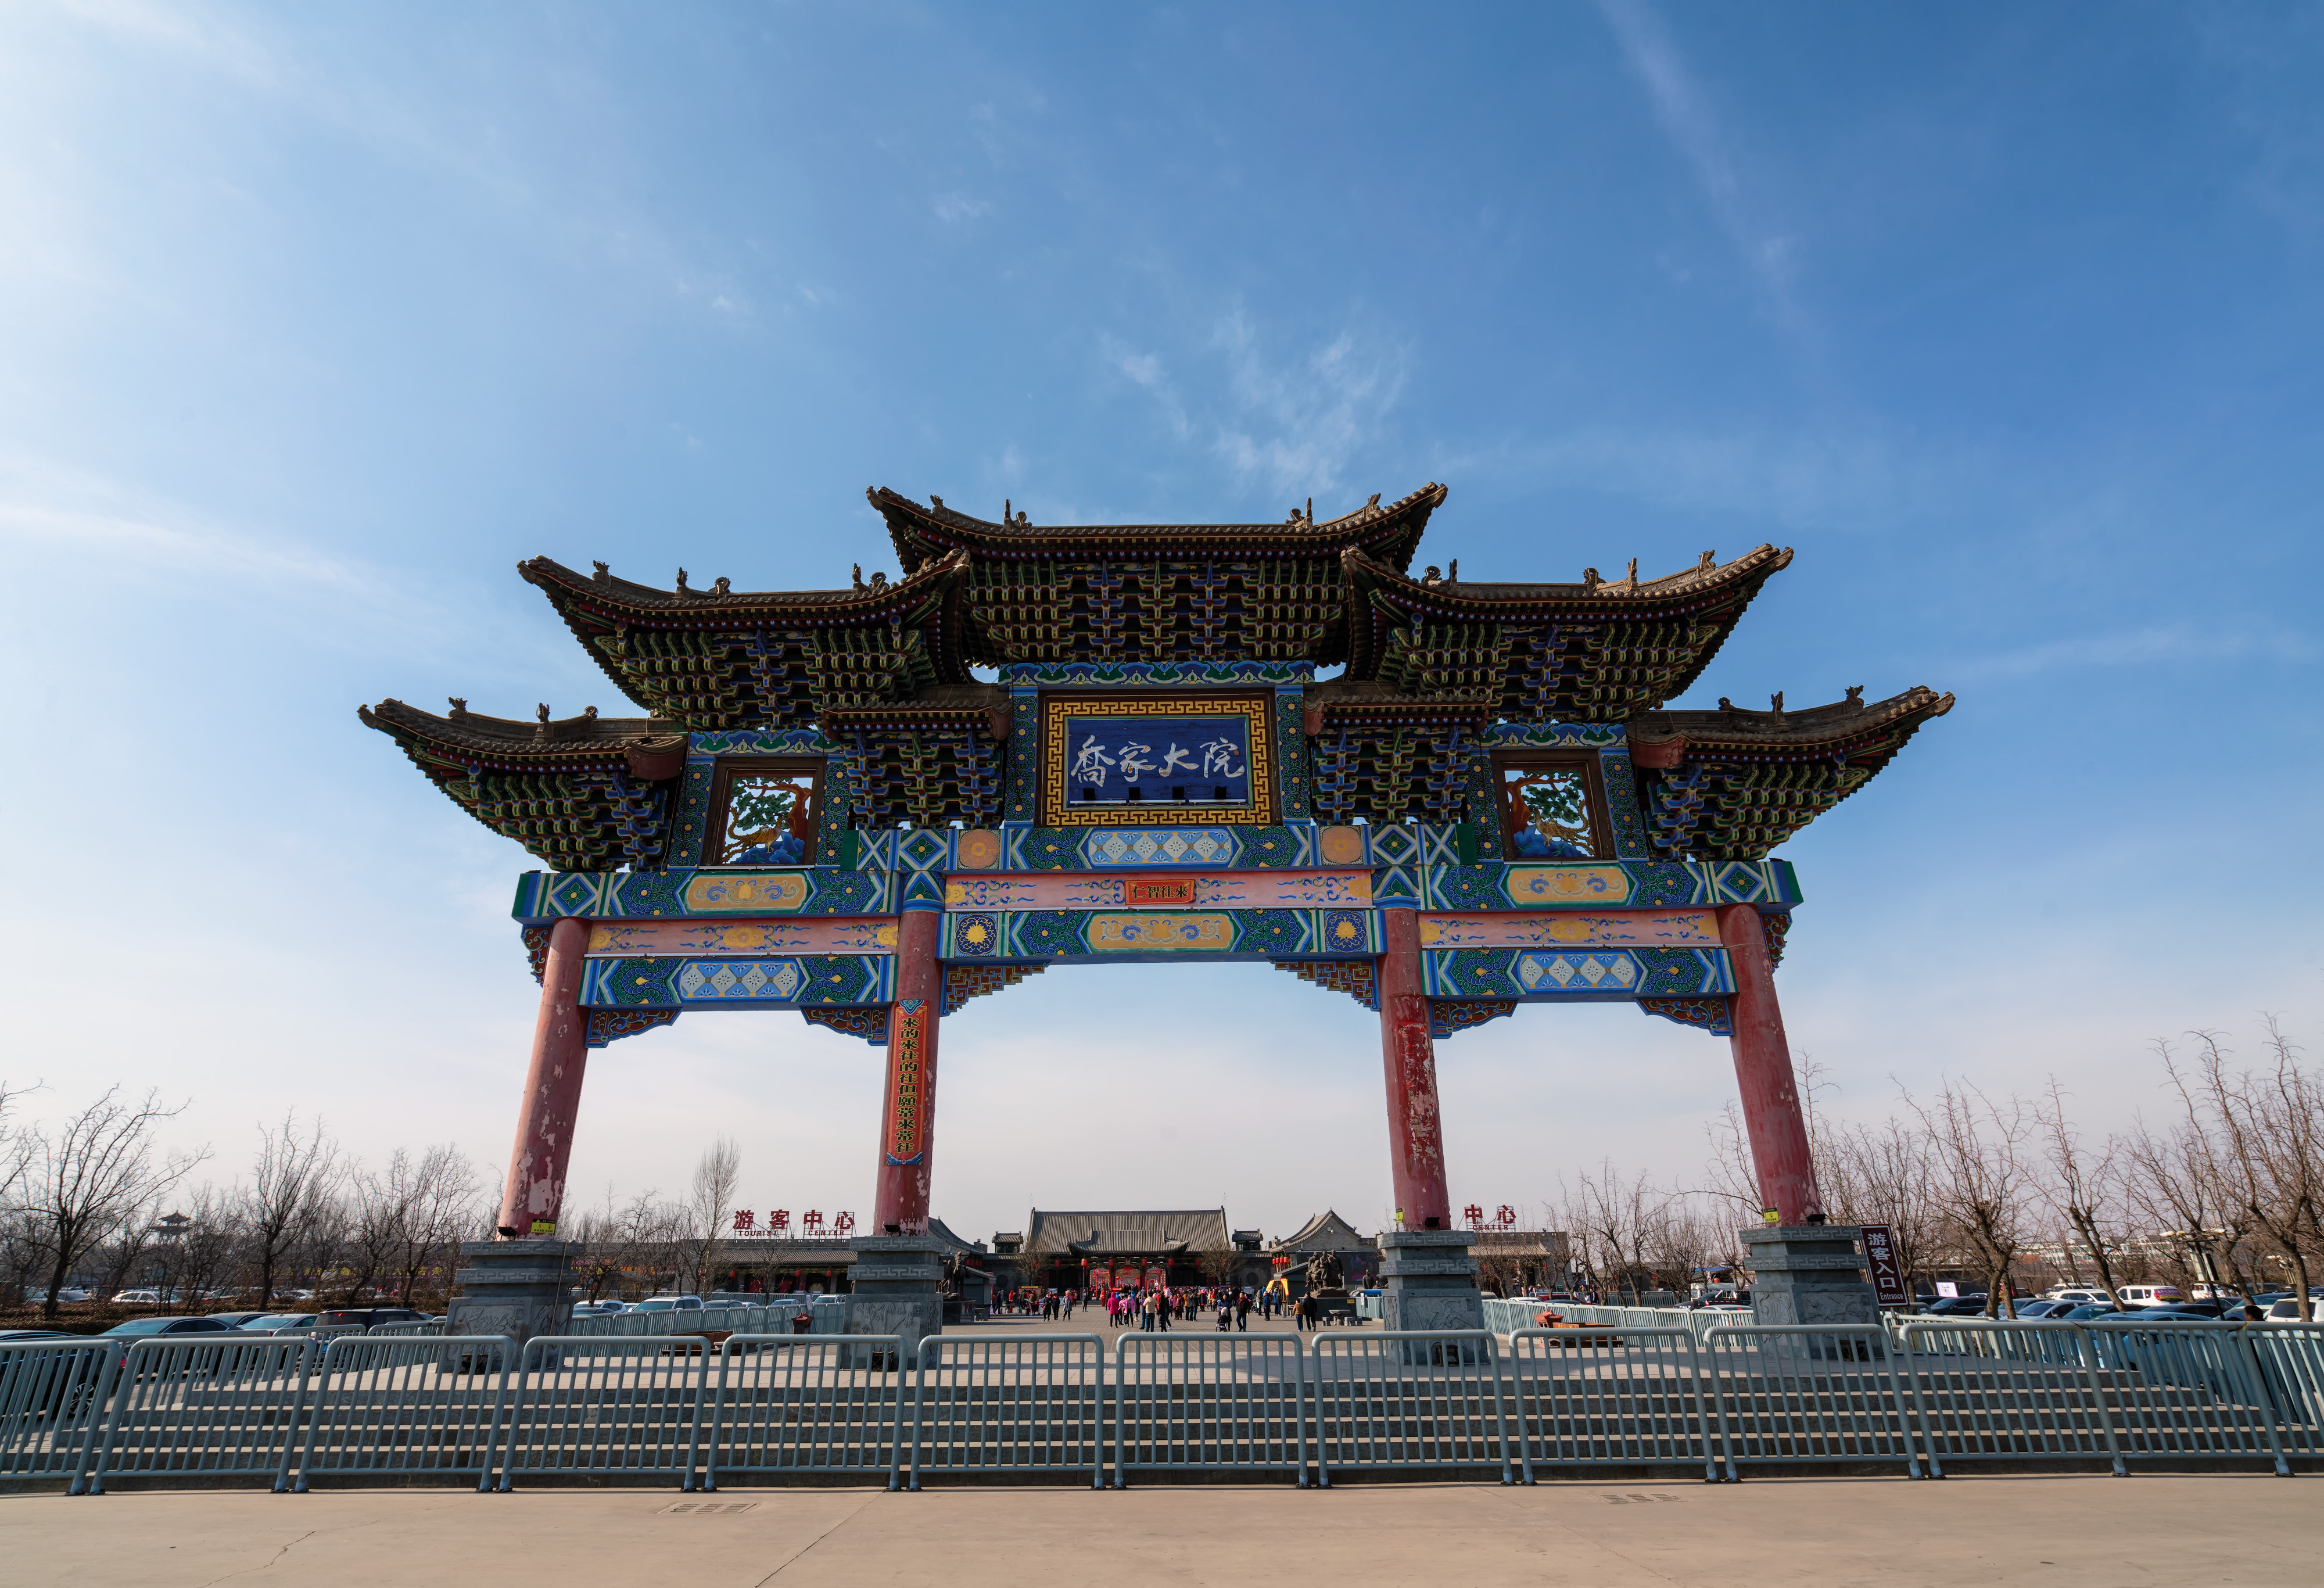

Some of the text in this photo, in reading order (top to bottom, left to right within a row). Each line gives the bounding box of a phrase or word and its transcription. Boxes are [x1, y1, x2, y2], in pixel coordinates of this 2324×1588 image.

[1070, 734, 1245, 787] 喬家大院
[1132, 884, 1188, 899] 仁智往來
[733, 1209, 855, 1230] 游客中心
[1464, 1205, 1516, 1224] 中心
[1867, 1232, 1896, 1289] 游客入口
[1880, 1292, 1903, 1300] Entrance
